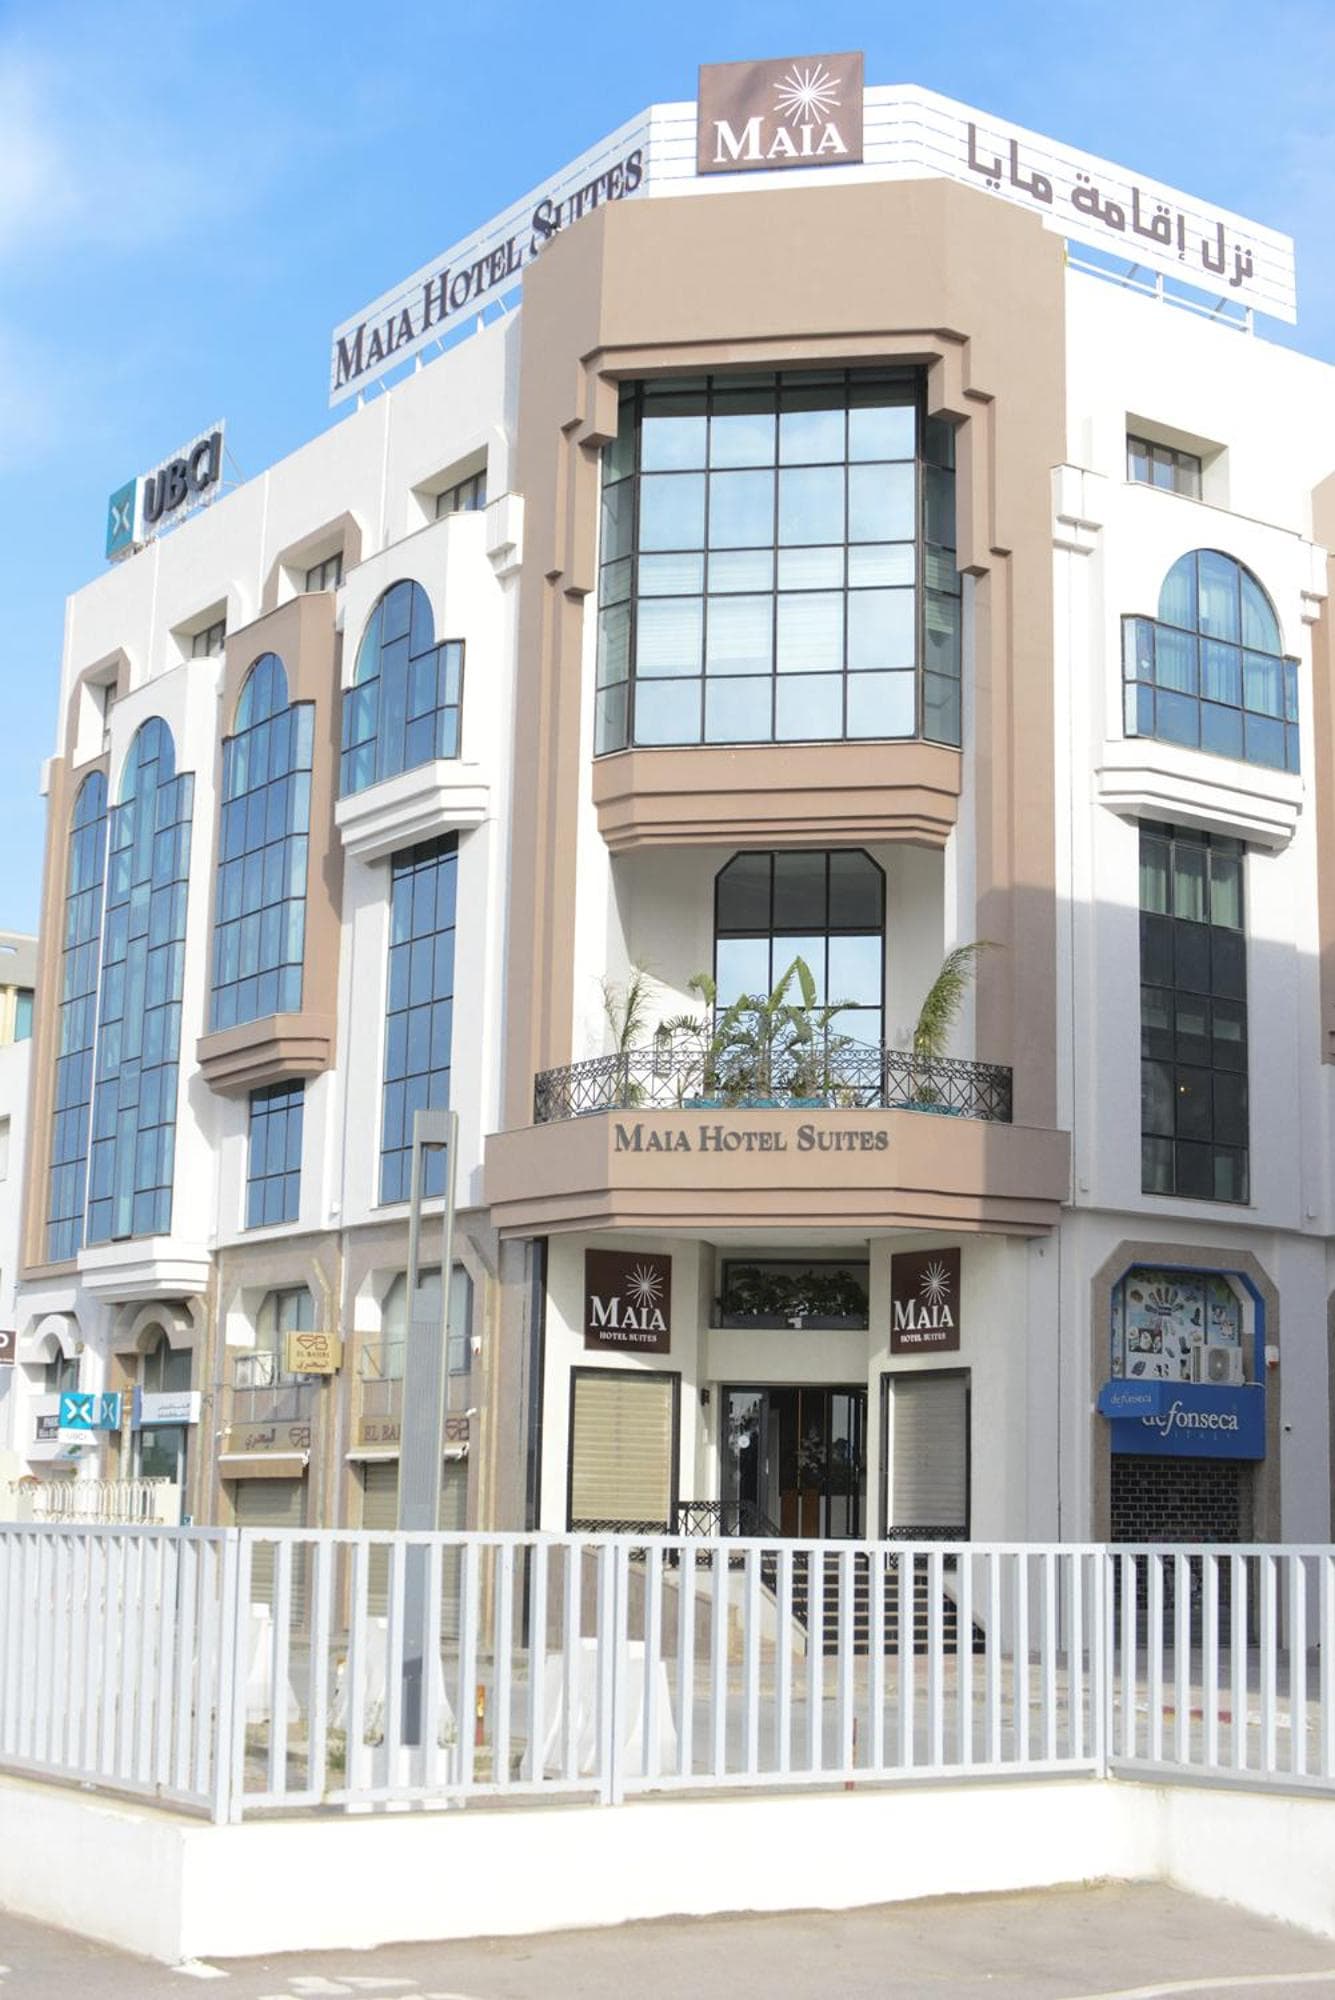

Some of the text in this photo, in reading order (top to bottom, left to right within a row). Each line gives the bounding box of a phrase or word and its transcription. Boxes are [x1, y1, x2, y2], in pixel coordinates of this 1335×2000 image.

[713, 116, 848, 163] MAIA
[967, 121, 1054, 205] مايا
[334, 148, 643, 390] MAIA HOTEL SUITES
[1201, 221, 1254, 287] نزل
[144, 431, 222, 523] UBCI
[614, 1123, 889, 1152] MAIA HOTEL SUITES
[590, 1295, 667, 1331] MAIA
[893, 1298, 954, 1331] MAIA
[599, 1331, 657, 1342] HOTEL SUITES
[900, 1332, 946, 1343] HOTEL SUITES
